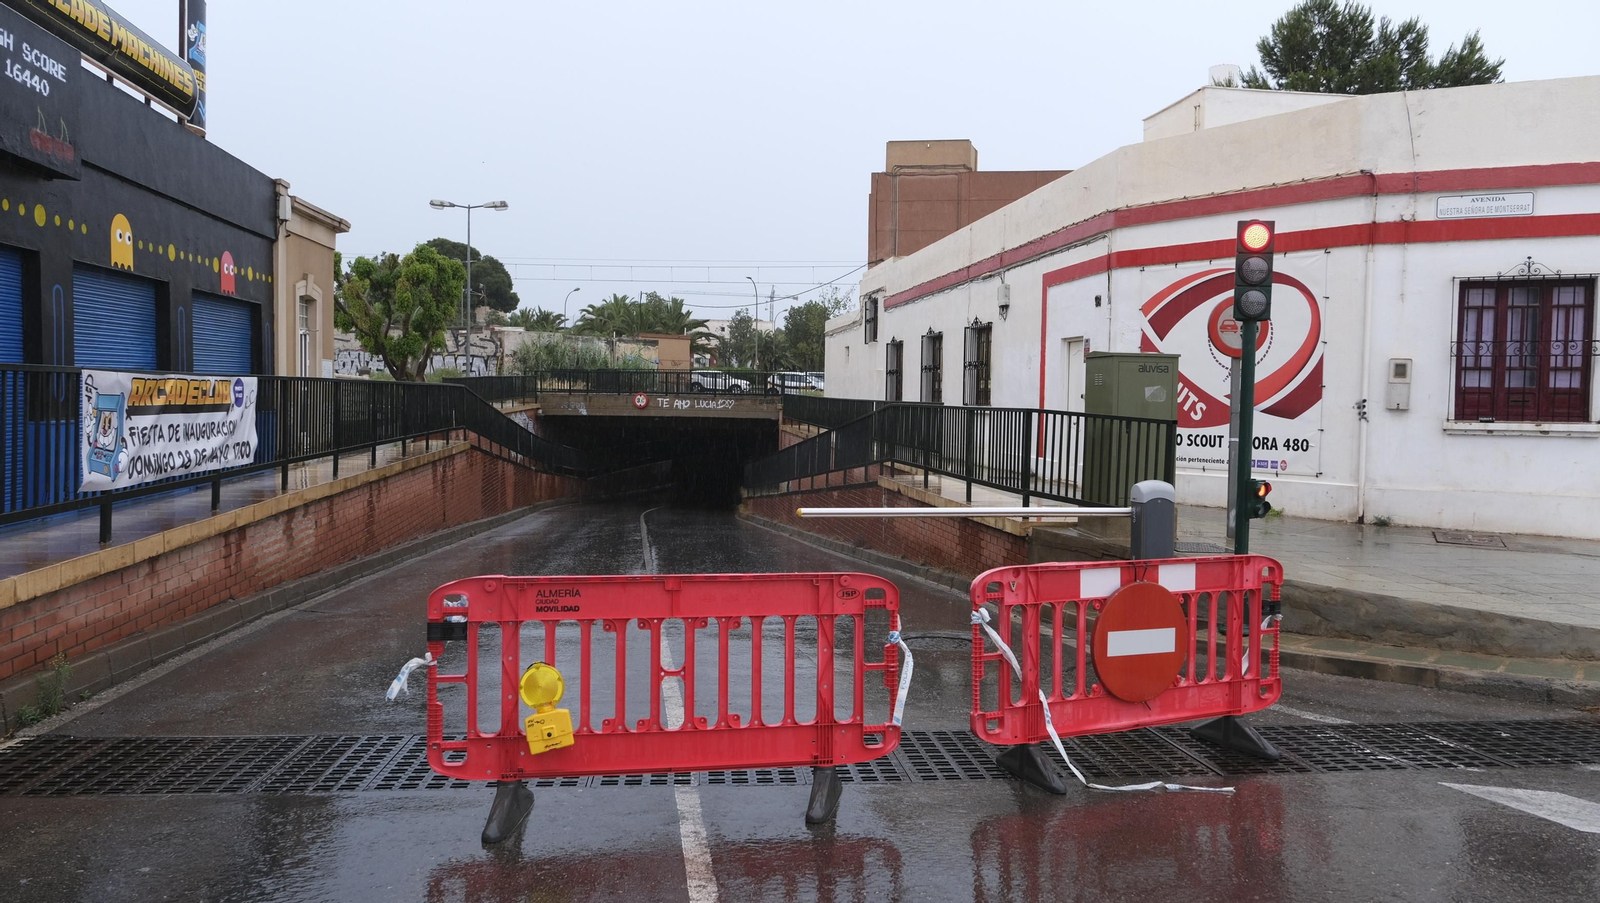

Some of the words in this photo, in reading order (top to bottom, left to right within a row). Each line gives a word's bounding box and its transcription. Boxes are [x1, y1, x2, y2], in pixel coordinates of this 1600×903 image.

[22, 42, 67, 83] SCORE
[111, 20, 193, 97] MACHINES
[5, 58, 50, 97] 16440
[1440, 207, 1463, 216] NUESTRA
[1464, 204, 1485, 215] SEÑORA
[1486, 205, 1493, 214] DE
[1494, 203, 1531, 213] MONTSERRAT
[1138, 363, 1169, 373] aluvisa
[656, 398, 670, 408] TE
[167, 423, 181, 443] DE
[1186, 433, 1225, 448] SCOUT
[1282, 438, 1310, 452] 480
[177, 449, 193, 470] 28
[1187, 456, 1225, 465] perteneciente
[535, 588, 581, 597] ALMERÍA
[841, 590, 857, 598] JSP
